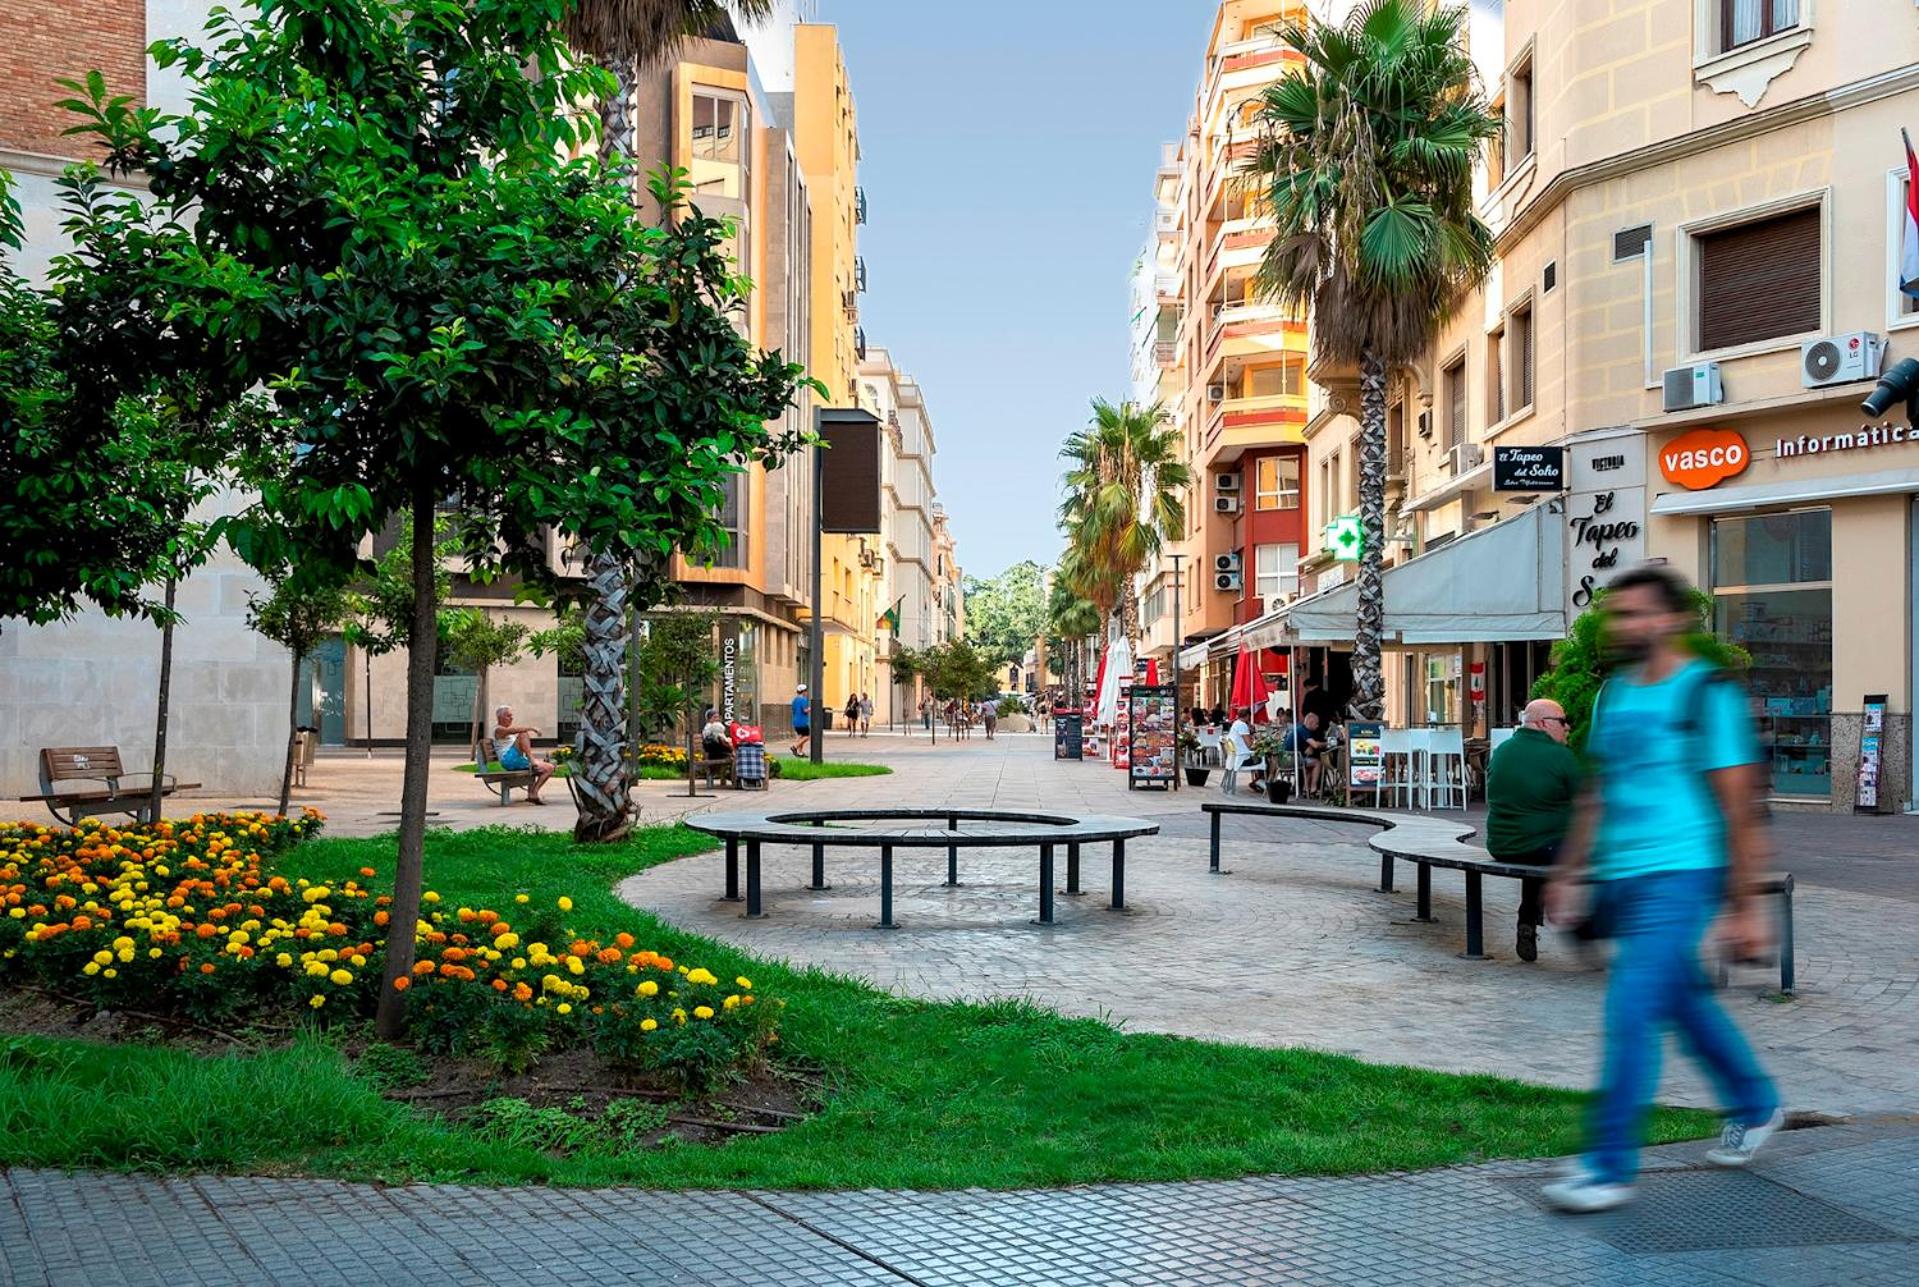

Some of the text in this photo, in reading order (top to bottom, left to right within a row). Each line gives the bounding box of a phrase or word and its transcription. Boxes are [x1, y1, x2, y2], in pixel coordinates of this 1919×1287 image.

[1849, 351, 1859, 359] LG
[1775, 420, 1919, 458] Informática
[1498, 449, 1543, 465] El Tapeo
[1592, 455, 1625, 470] VICTORIA
[1664, 444, 1743, 473] vasco
[1514, 464, 1559, 477] del Soho
[1594, 491, 1615, 514] El
[1570, 514, 1640, 552] Tapeo
[1592, 547, 1618, 569] del
[724, 637, 735, 727] APARTAMENTOS
